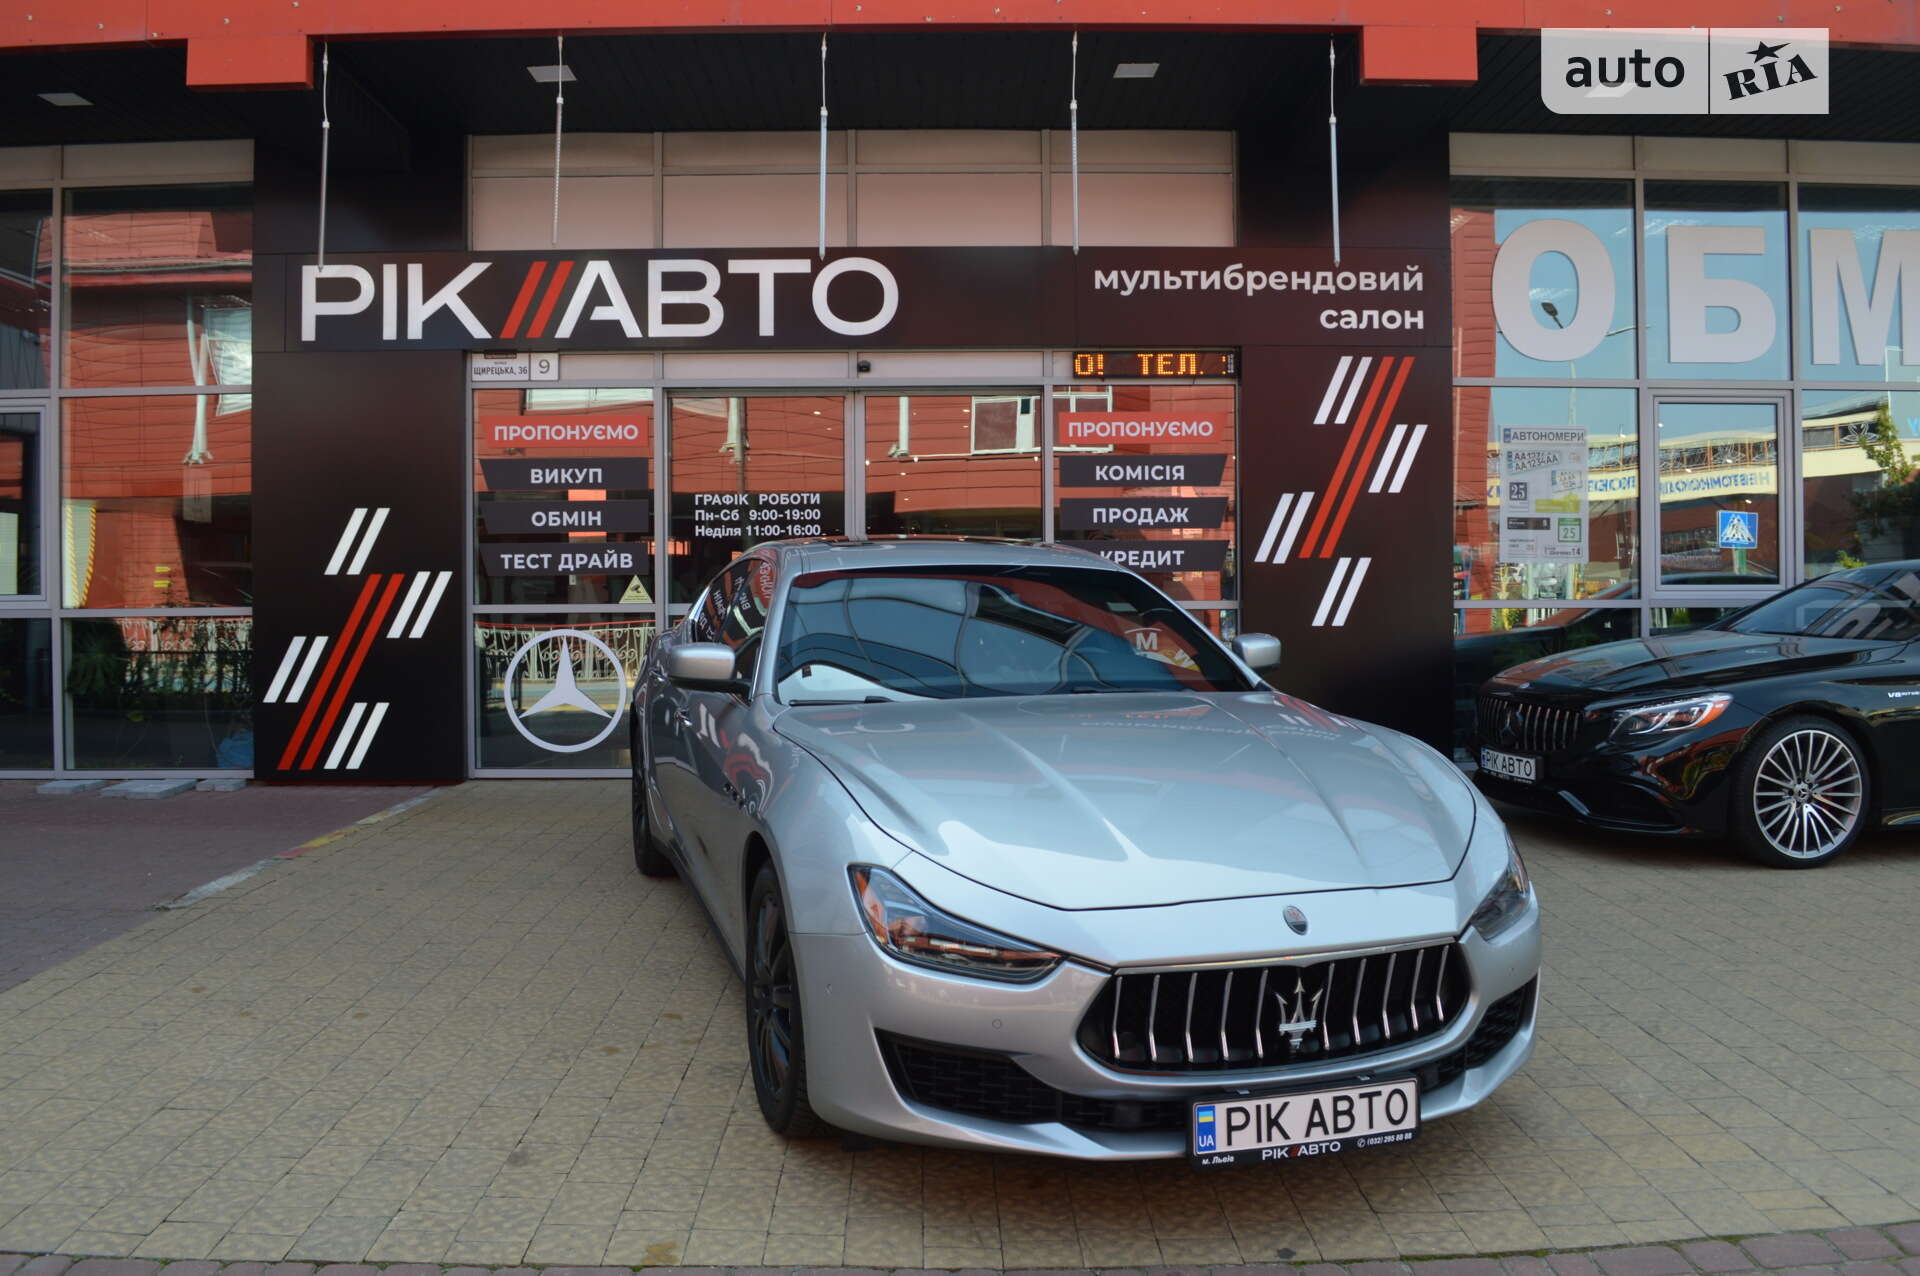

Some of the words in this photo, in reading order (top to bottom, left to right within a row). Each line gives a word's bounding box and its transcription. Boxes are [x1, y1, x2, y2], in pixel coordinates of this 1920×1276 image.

[1094, 264, 1424, 296] мультибрендовий
[554, 257, 899, 339] АВТО
[1492, 218, 1920, 367] ОБМ
[1319, 308, 1424, 329] салон
[518, 366, 528, 375] 36
[538, 359, 550, 374] 9
[494, 425, 639, 441] ПРОПОНУЄМО
[1068, 420, 1213, 437] ПРОПОНУЄМО
[1512, 431, 1584, 441] АВТОНОМЕРИ
[530, 468, 603, 484] ВИКУП
[1095, 465, 1185, 481] КОМІСІЯ
[694, 494, 749, 506] ГРАФІК
[759, 493, 821, 505] РОБОТИ
[1511, 484, 1526, 500] 25
[531, 511, 602, 527] ОБМІН
[695, 508, 740, 521] Пн-Сб
[749, 508, 821, 521] 9:00-19:00
[1093, 508, 1190, 525] ПРОДАЖ
[695, 525, 742, 539] Неділя
[745, 524, 821, 537] 11:00-16:00
[1562, 527, 1576, 539] 25
[500, 554, 552, 569] ТЕСТ
[558, 550, 634, 572] ДРАЙВ
[1304, 1088, 1408, 1138] АВТО
[1199, 1135, 1215, 1147] UA
[1297, 1141, 1341, 1157] АВТО
